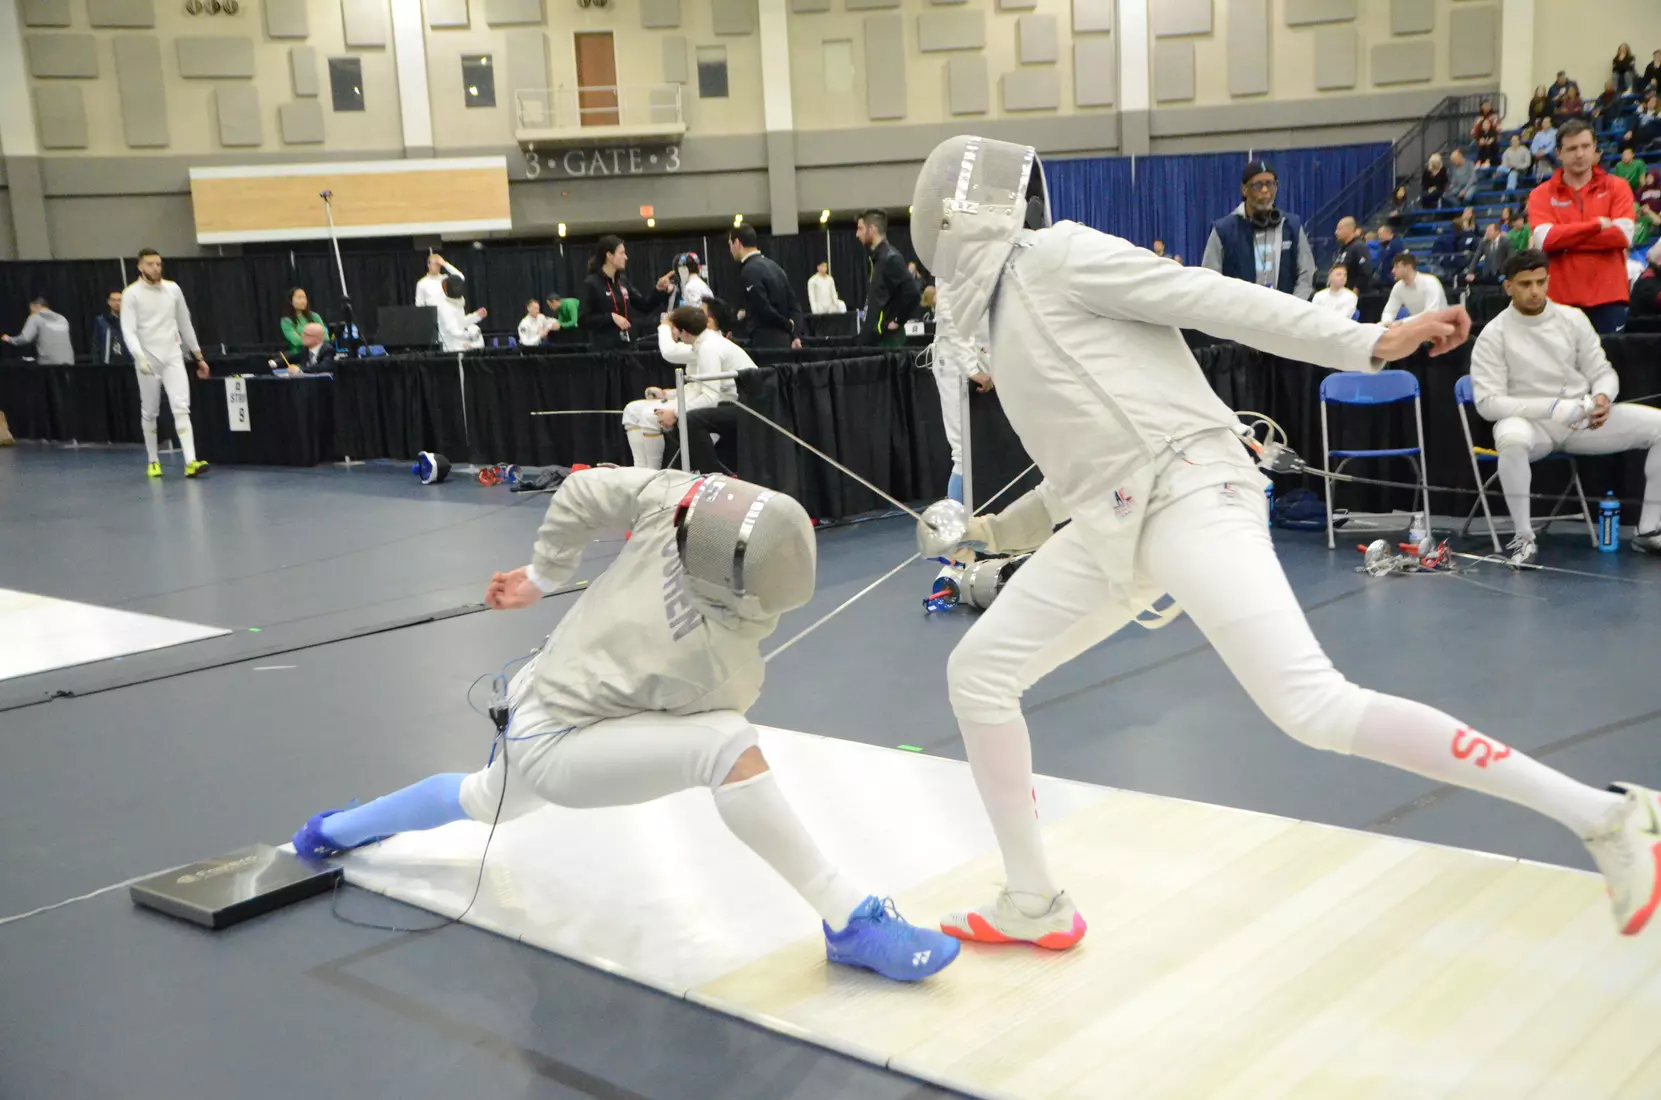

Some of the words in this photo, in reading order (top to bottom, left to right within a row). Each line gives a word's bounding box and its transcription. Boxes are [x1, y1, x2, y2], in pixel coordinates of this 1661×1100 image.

[525, 152, 541, 180] 3
[563, 148, 643, 177] GATE
[665, 145, 681, 173] 3
